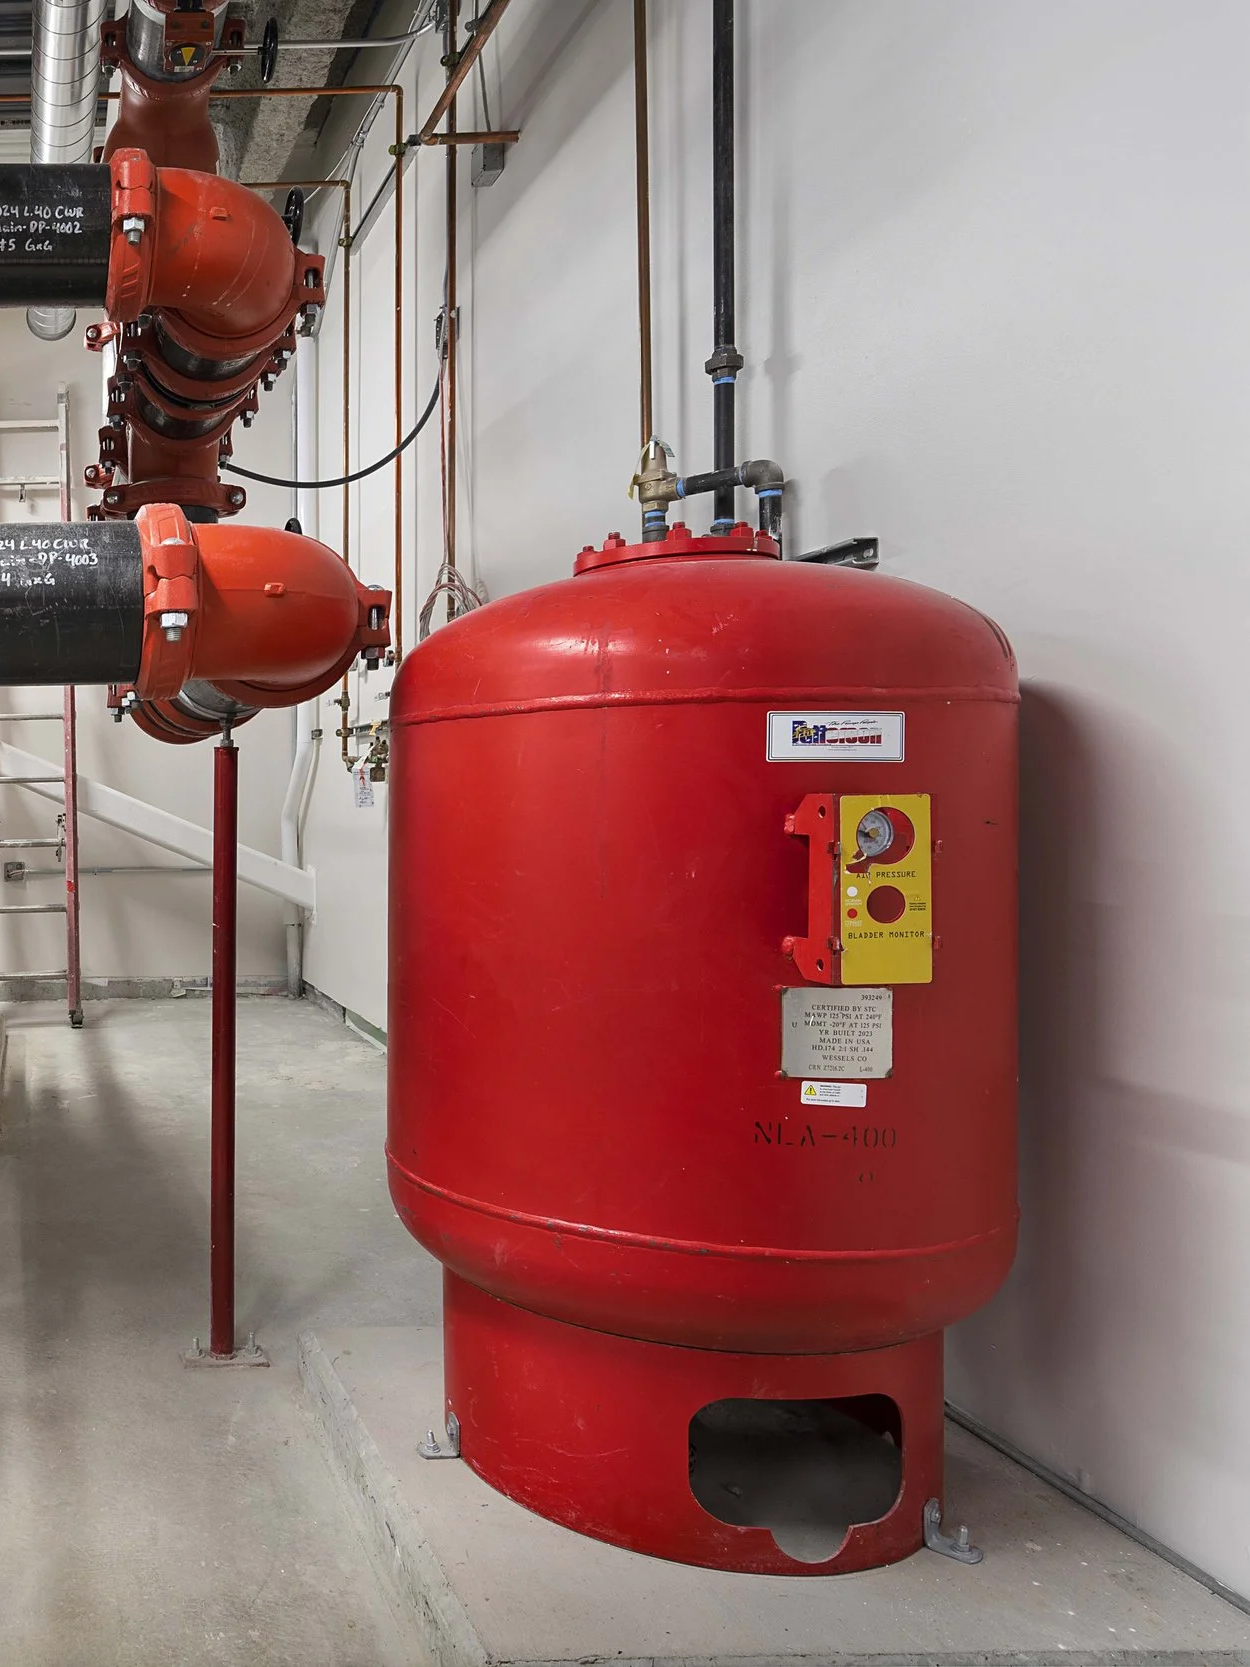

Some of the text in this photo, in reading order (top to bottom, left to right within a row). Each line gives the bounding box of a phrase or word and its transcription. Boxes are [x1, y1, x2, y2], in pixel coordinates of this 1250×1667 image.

[23, 205, 52, 219] L.40
[55, 205, 84, 219] CWR
[876, 870, 916, 878] PRESSURE
[812, 1004, 850, 1012] CERTIFIED
[822, 1054, 855, 1062] WESSELS
[754, 1121, 897, 1148] NLA-400
